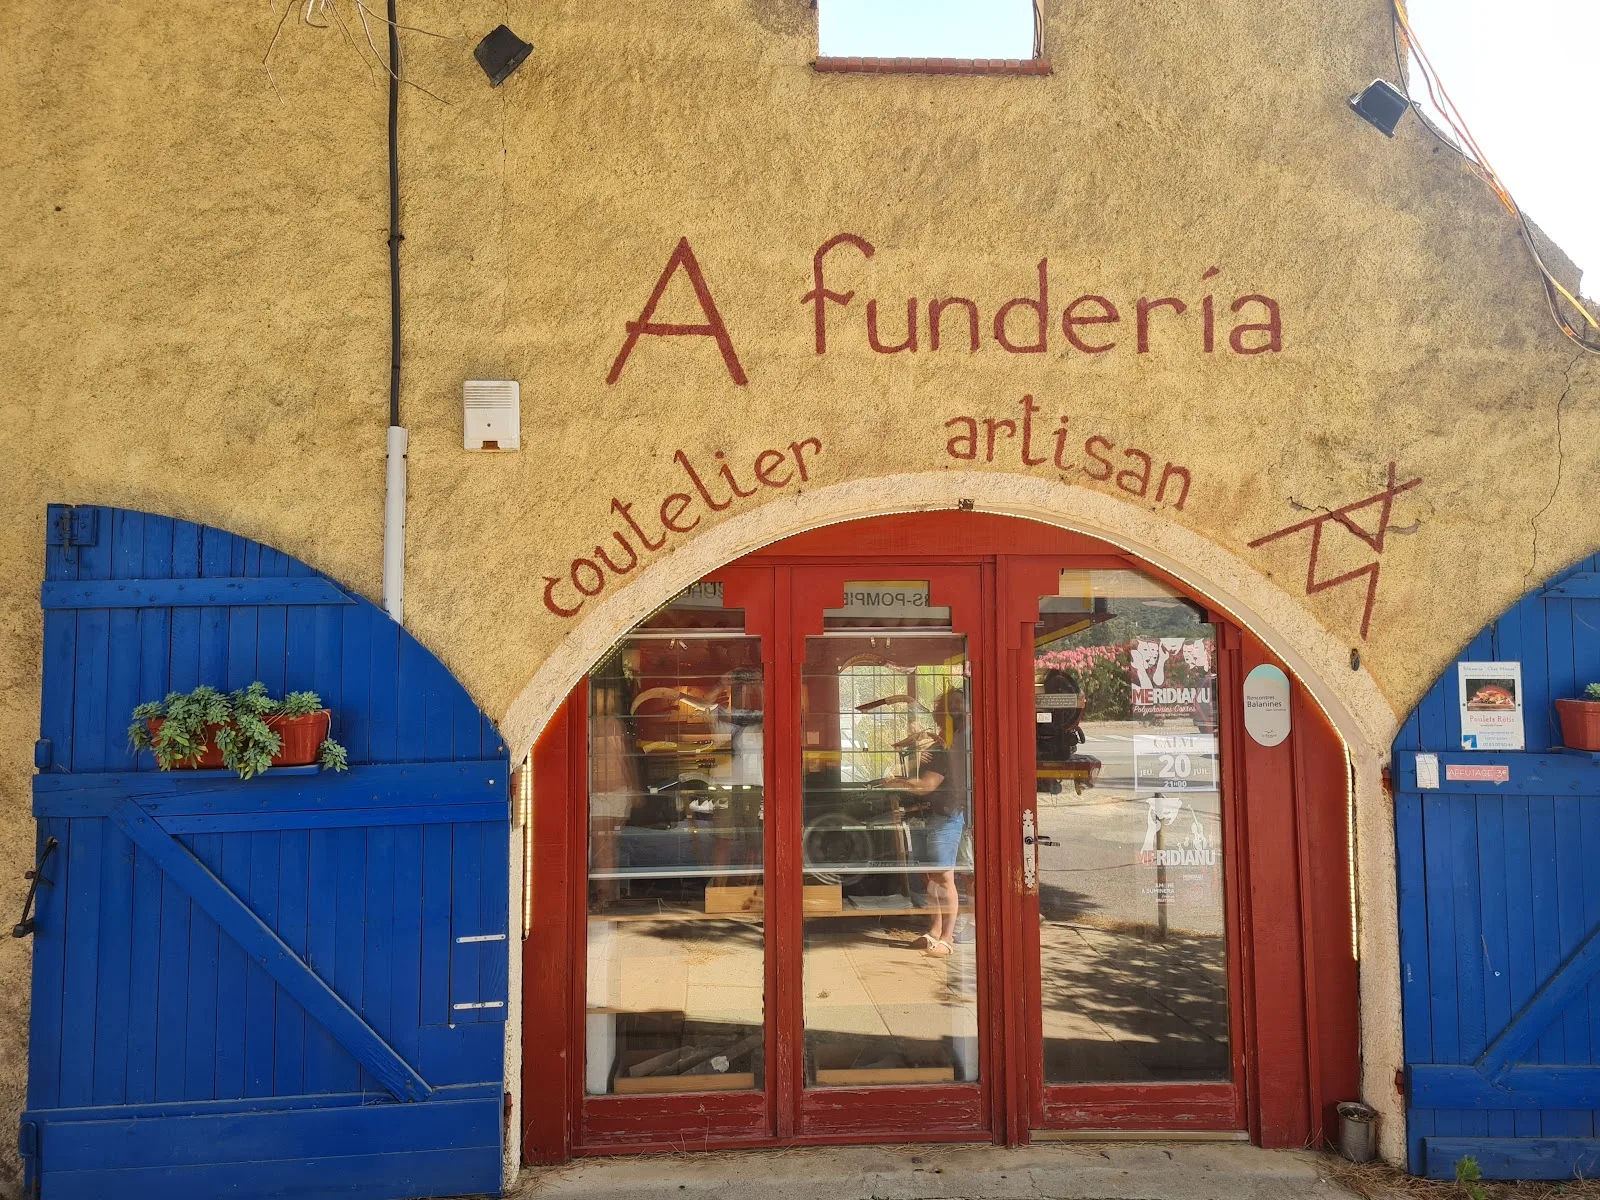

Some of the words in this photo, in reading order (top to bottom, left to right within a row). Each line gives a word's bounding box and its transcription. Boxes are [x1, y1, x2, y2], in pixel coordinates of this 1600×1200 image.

[606, 236, 748, 386] A
[542, 436, 823, 617] coutelier
[945, 394, 1192, 510] artisan
[1131, 687, 1211, 704] MERIDIANU
[1133, 704, 1173, 716] Polyphonies
[1469, 715, 1496, 723] Poulets
[1139, 769, 1155, 777] JEU.
[1158, 754, 1191, 778] 20
[1193, 768, 1211, 776] JUIL.
[1448, 769, 1493, 777] AFFUTAGE
